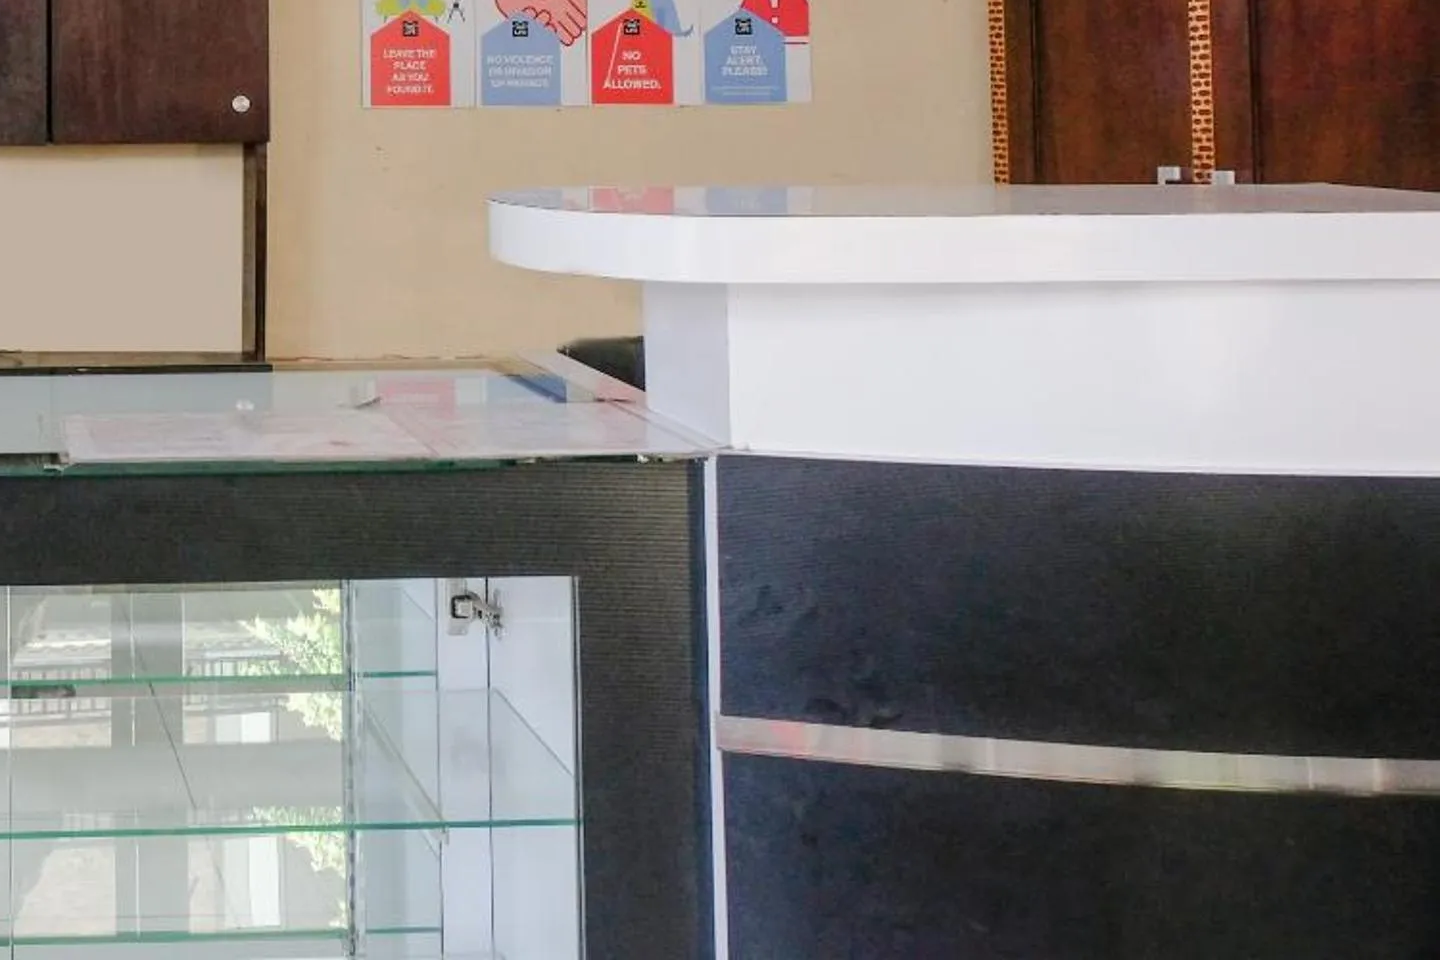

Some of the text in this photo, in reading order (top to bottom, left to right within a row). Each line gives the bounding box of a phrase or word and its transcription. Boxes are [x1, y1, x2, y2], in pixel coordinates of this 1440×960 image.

[416, 48, 437, 59] THE
[622, 50, 642, 61] NO
[392, 60, 427, 70] PLACE
[617, 64, 648, 75] PETS
